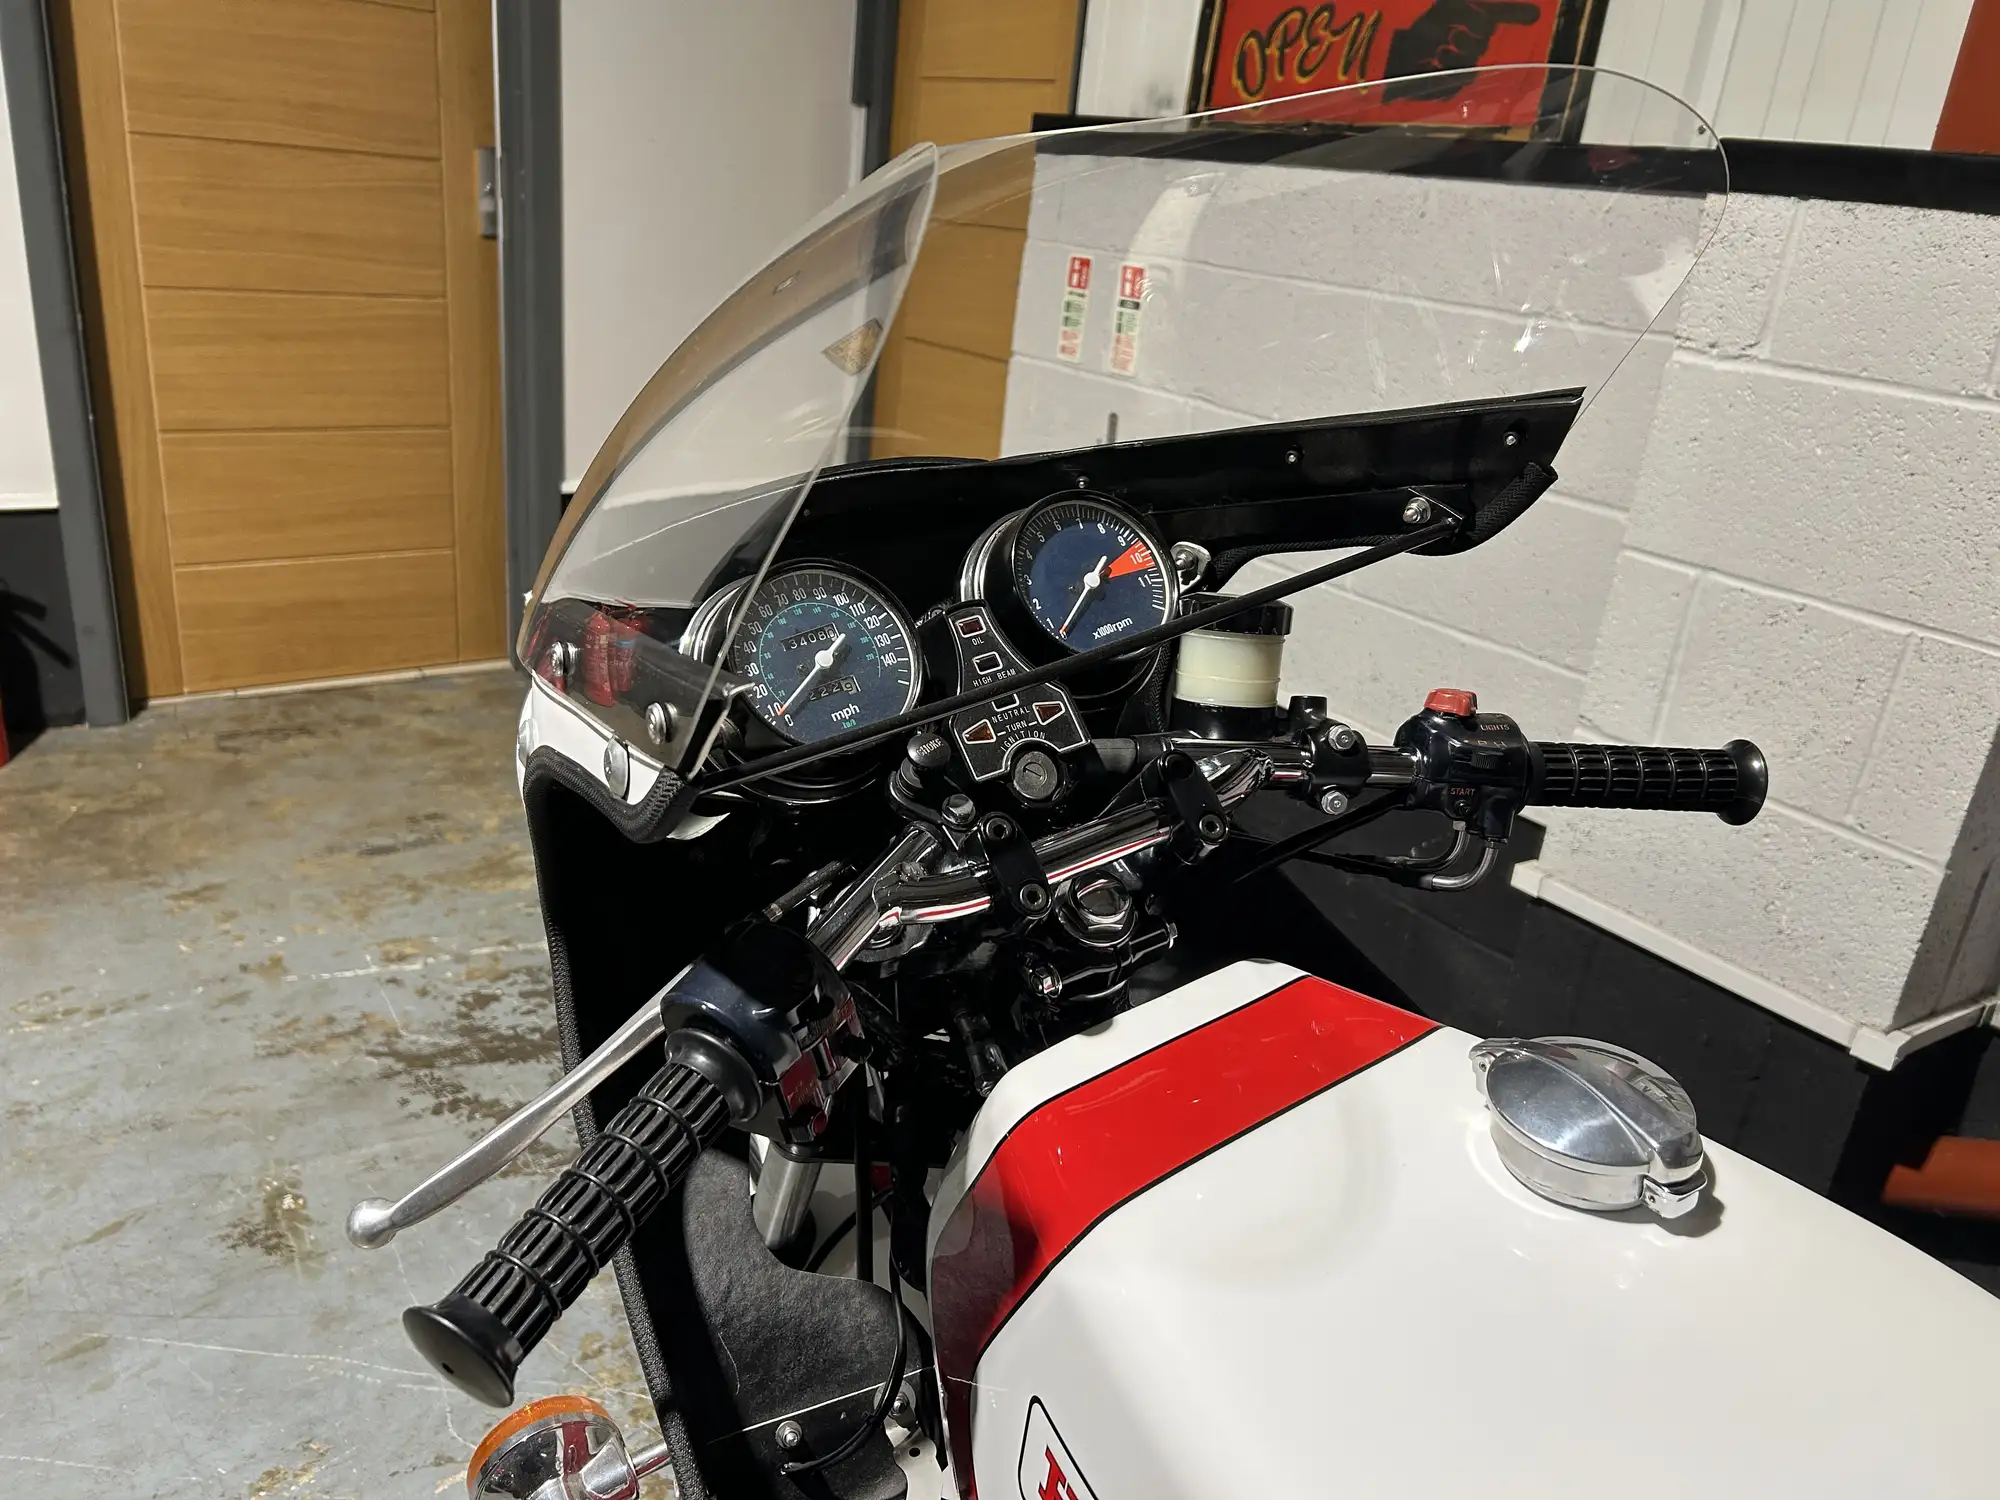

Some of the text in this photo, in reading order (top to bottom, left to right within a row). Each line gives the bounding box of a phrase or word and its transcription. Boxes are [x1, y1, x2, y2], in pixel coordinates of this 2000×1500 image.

[1231, 2, 1382, 99] OPEN
[1053, 520, 1062, 531] 6
[1096, 523, 1106, 534] 8
[1036, 532, 1046, 543] 5
[1117, 535, 1127, 547] 9
[1130, 552, 1143, 565] 10
[1023, 575, 1032, 585] 3
[1137, 574, 1152, 588] 11
[774, 593, 789, 607] 70
[792, 588, 807, 601] 80
[813, 587, 827, 600] 90
[833, 592, 850, 607] 100
[758, 604, 773, 618] 60
[849, 602, 866, 617] 110
[1032, 598, 1042, 610] 2
[747, 621, 763, 635] 50
[863, 614, 880, 630] 120
[1046, 617, 1054, 629] 1
[743, 640, 757, 654] 40
[874, 632, 891, 648] 130
[971, 637, 985, 646] OIL
[880, 652, 897, 667] 140
[745, 662, 760, 677] 30
[973, 668, 1017, 687] HIGH BEAM
[753, 683, 768, 699] 20
[767, 701, 782, 717] 10
[831, 703, 860, 722] mph
[991, 706, 1030, 724] NEUTRAL
[784, 714, 794, 727] 0
[1006, 720, 1028, 733] TURN
[1001, 730, 1046, 752] IGNITION
[1450, 787, 1476, 796] START
